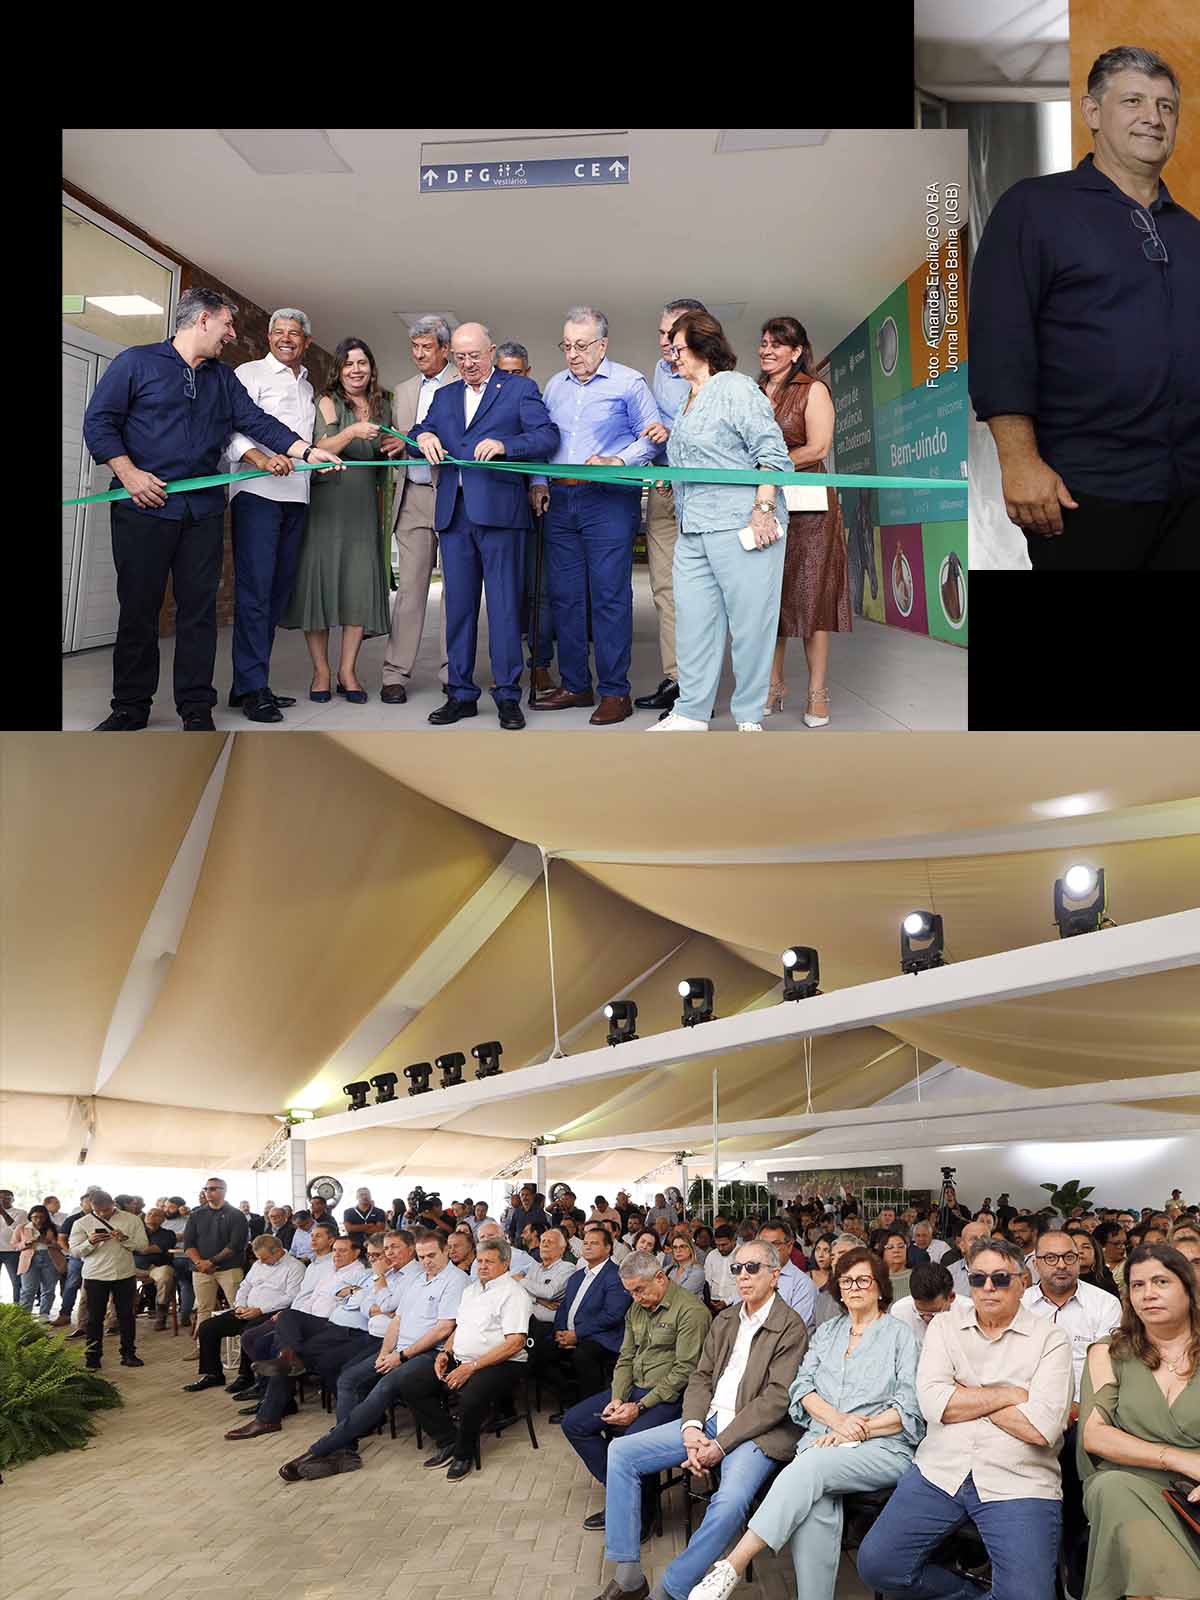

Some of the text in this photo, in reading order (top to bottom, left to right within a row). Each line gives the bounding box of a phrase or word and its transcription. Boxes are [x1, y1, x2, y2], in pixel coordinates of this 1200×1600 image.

[447, 168, 491, 184] D F G
[574, 163, 601, 177] C E
